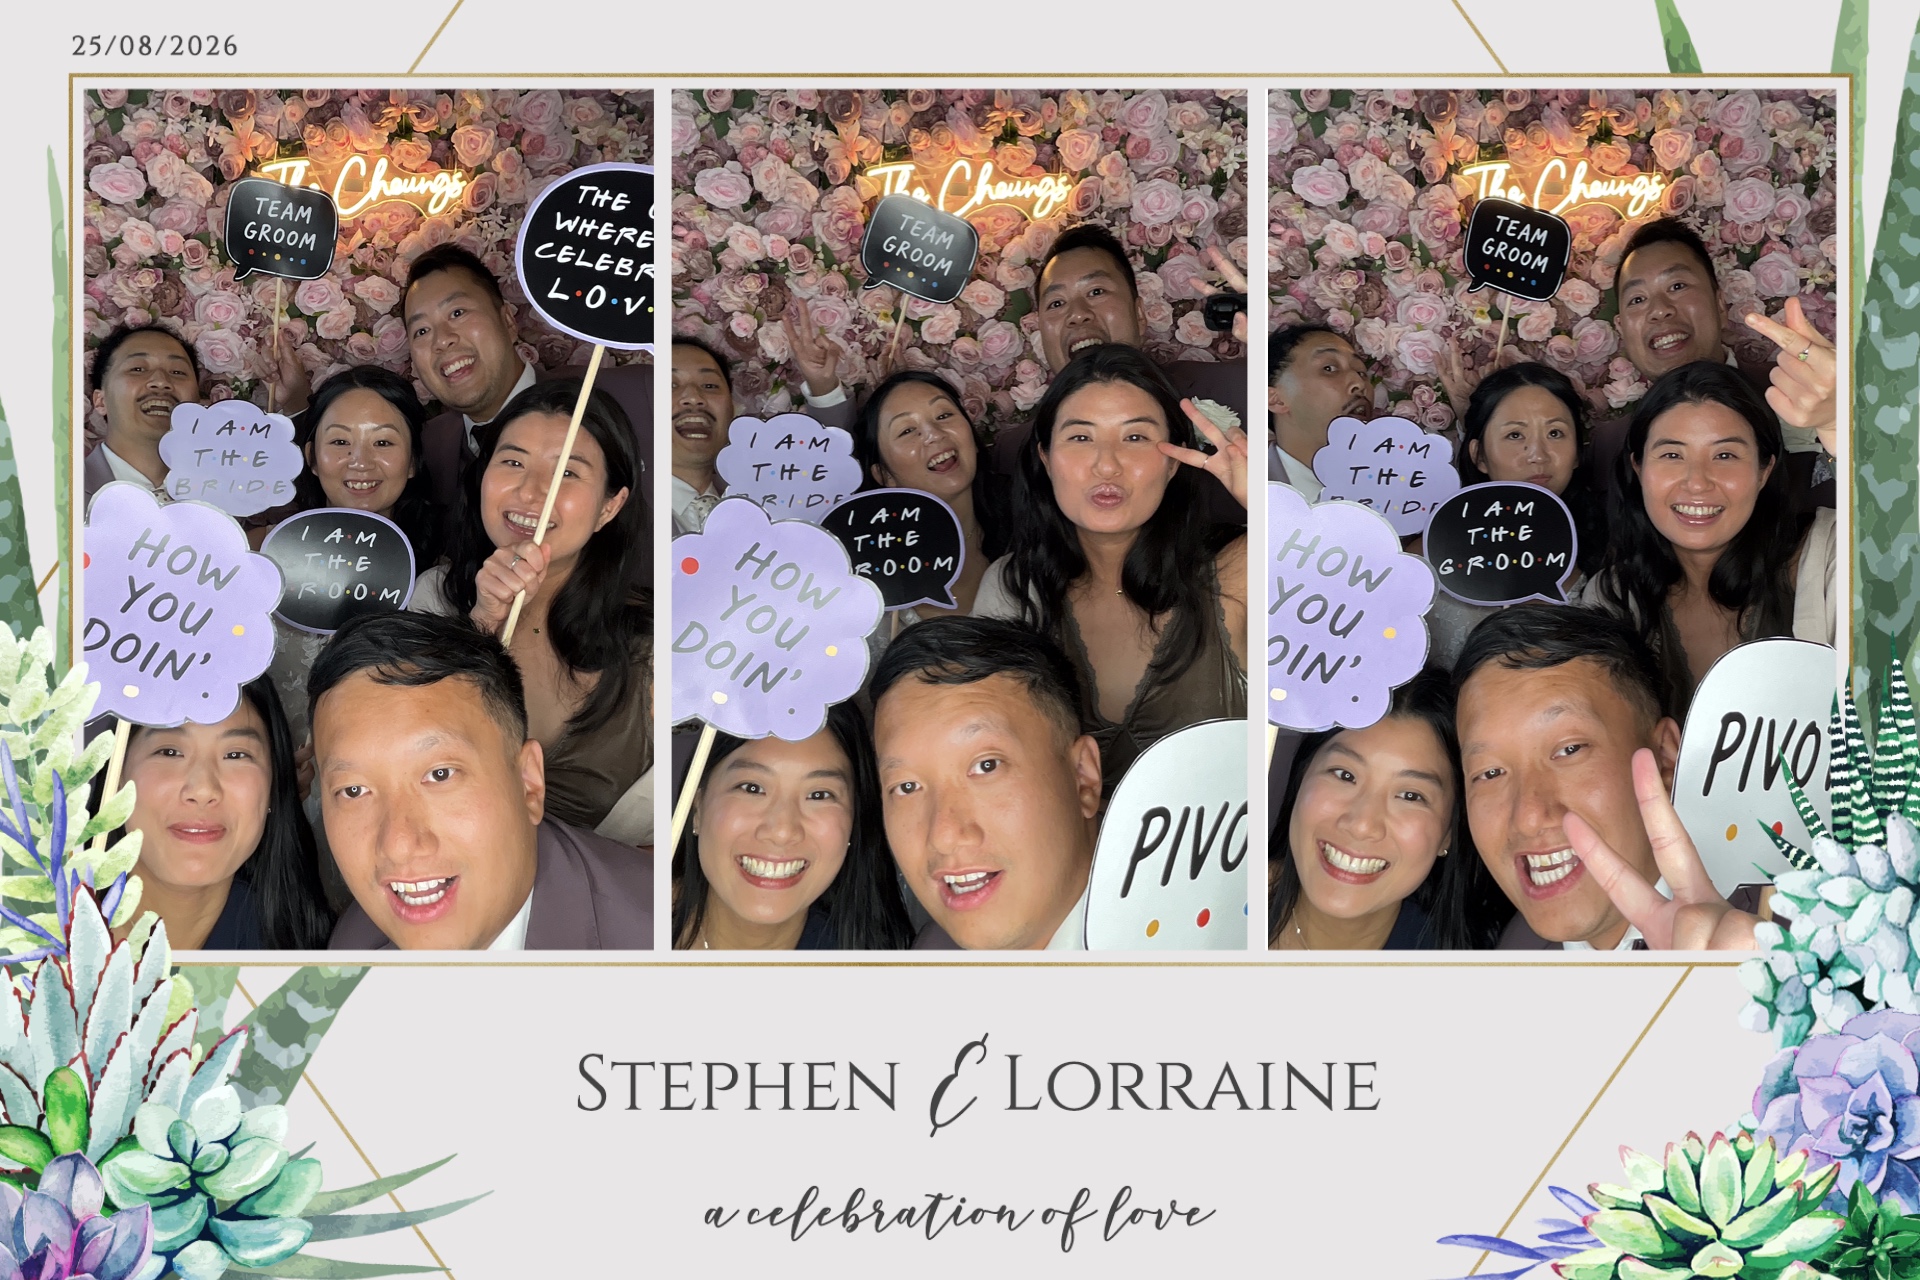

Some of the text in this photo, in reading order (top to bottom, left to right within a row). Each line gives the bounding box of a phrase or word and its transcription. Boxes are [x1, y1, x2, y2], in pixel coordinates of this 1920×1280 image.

[261, 160, 321, 190] Th
[255, 197, 313, 225] TEAM
[578, 185, 631, 212] THE
[244, 221, 317, 252] GROOM
[555, 211, 655, 248] WHERE
[899, 213, 955, 250] TEAM
[1495, 215, 1549, 247] TEAM
[882, 235, 954, 276] GROOM
[1481, 237, 1550, 274] GROOM
[191, 418, 199, 435] I
[749, 432, 758, 449] I
[1349, 433, 1357, 451] I
[847, 510, 855, 526] I
[1461, 502, 1469, 518] I
[301, 525, 310, 542] I
[127, 527, 241, 592] HOW
[734, 541, 842, 610] HOW
[1276, 528, 1394, 593] HOW
[119, 575, 214, 637] YOU
[719, 585, 810, 652] YOU
[1268, 575, 1365, 639] YOU
[672, 620, 803, 694] DOIN'
[1120, 800, 1248, 899] PIVO
